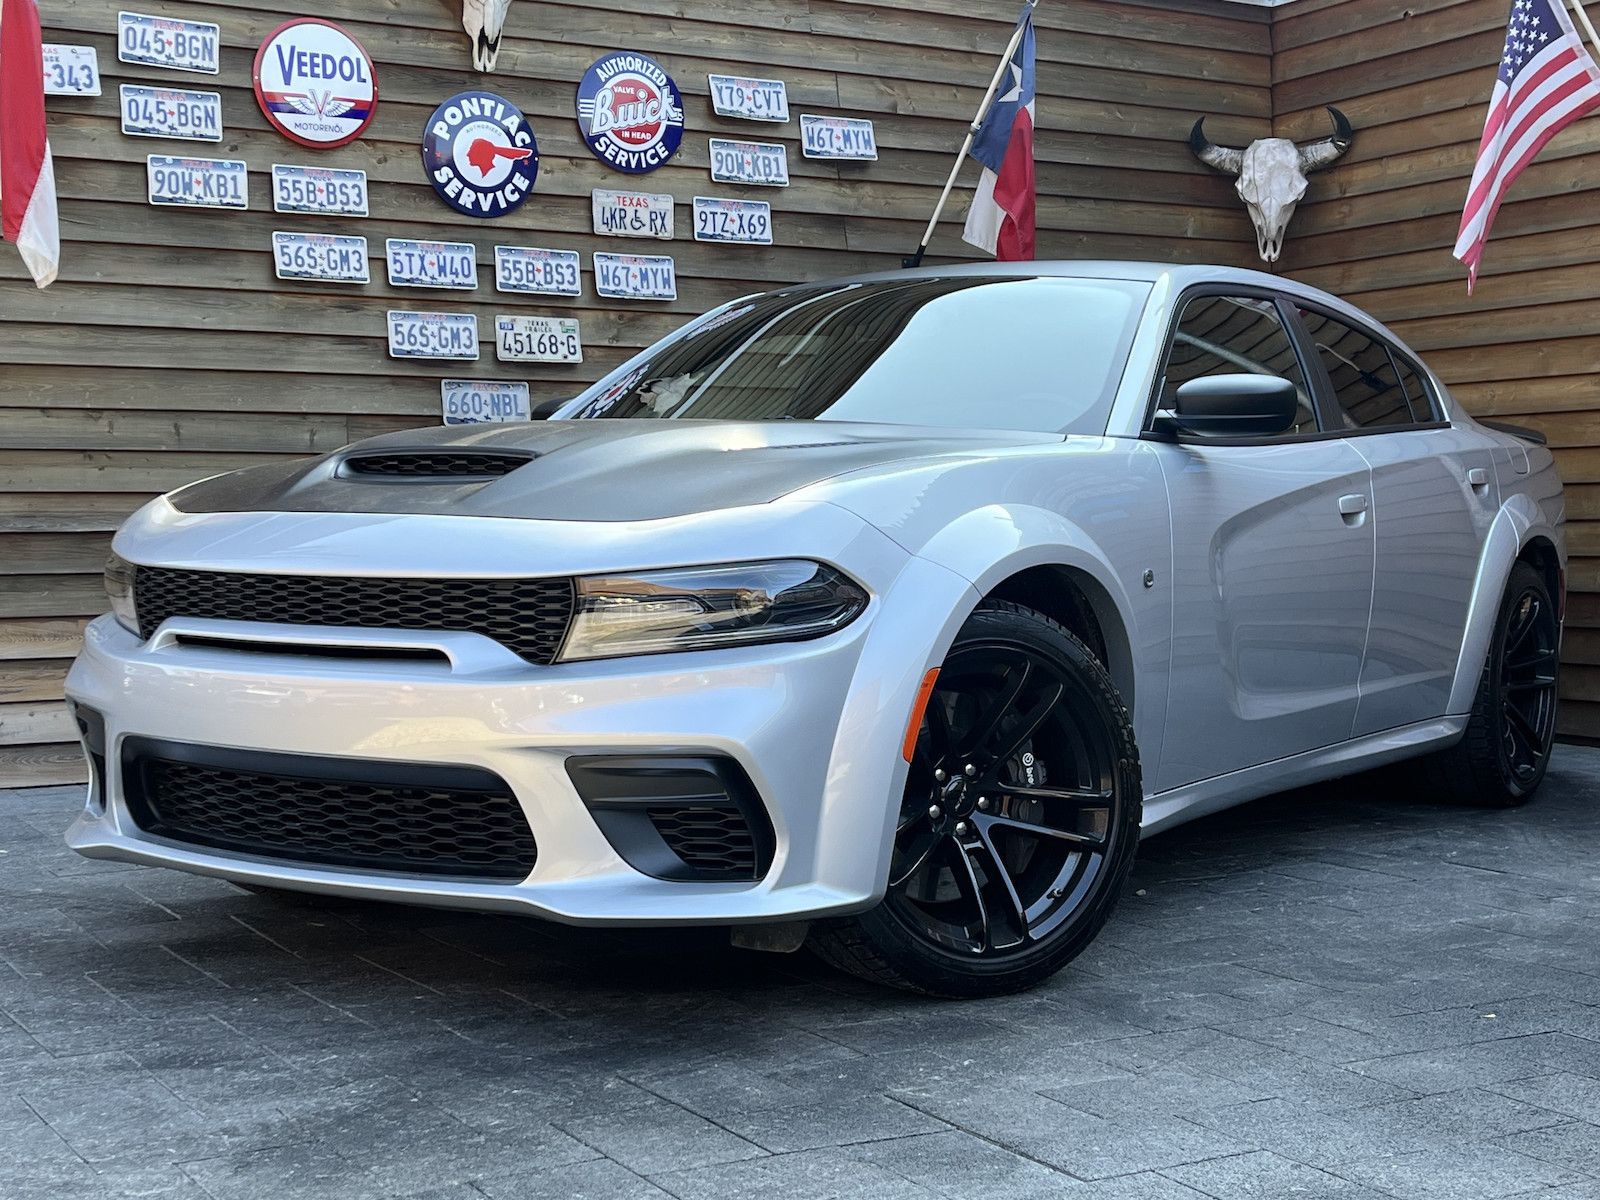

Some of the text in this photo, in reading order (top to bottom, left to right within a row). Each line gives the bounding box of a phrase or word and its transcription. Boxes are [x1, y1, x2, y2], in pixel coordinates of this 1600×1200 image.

[276, 44, 367, 86] VEEDOL
[595, 56, 667, 86] AUTHORIZED
[613, 86, 635, 95] VALVE
[432, 97, 531, 147] PONTIAC
[589, 85, 681, 136] Buick
[294, 122, 344, 134] MOTORENÖL
[631, 131, 652, 140] HEAD
[594, 136, 669, 168] SERVICE
[434, 166, 530, 212] SERVICE
[616, 195, 649, 209] TEXAS
